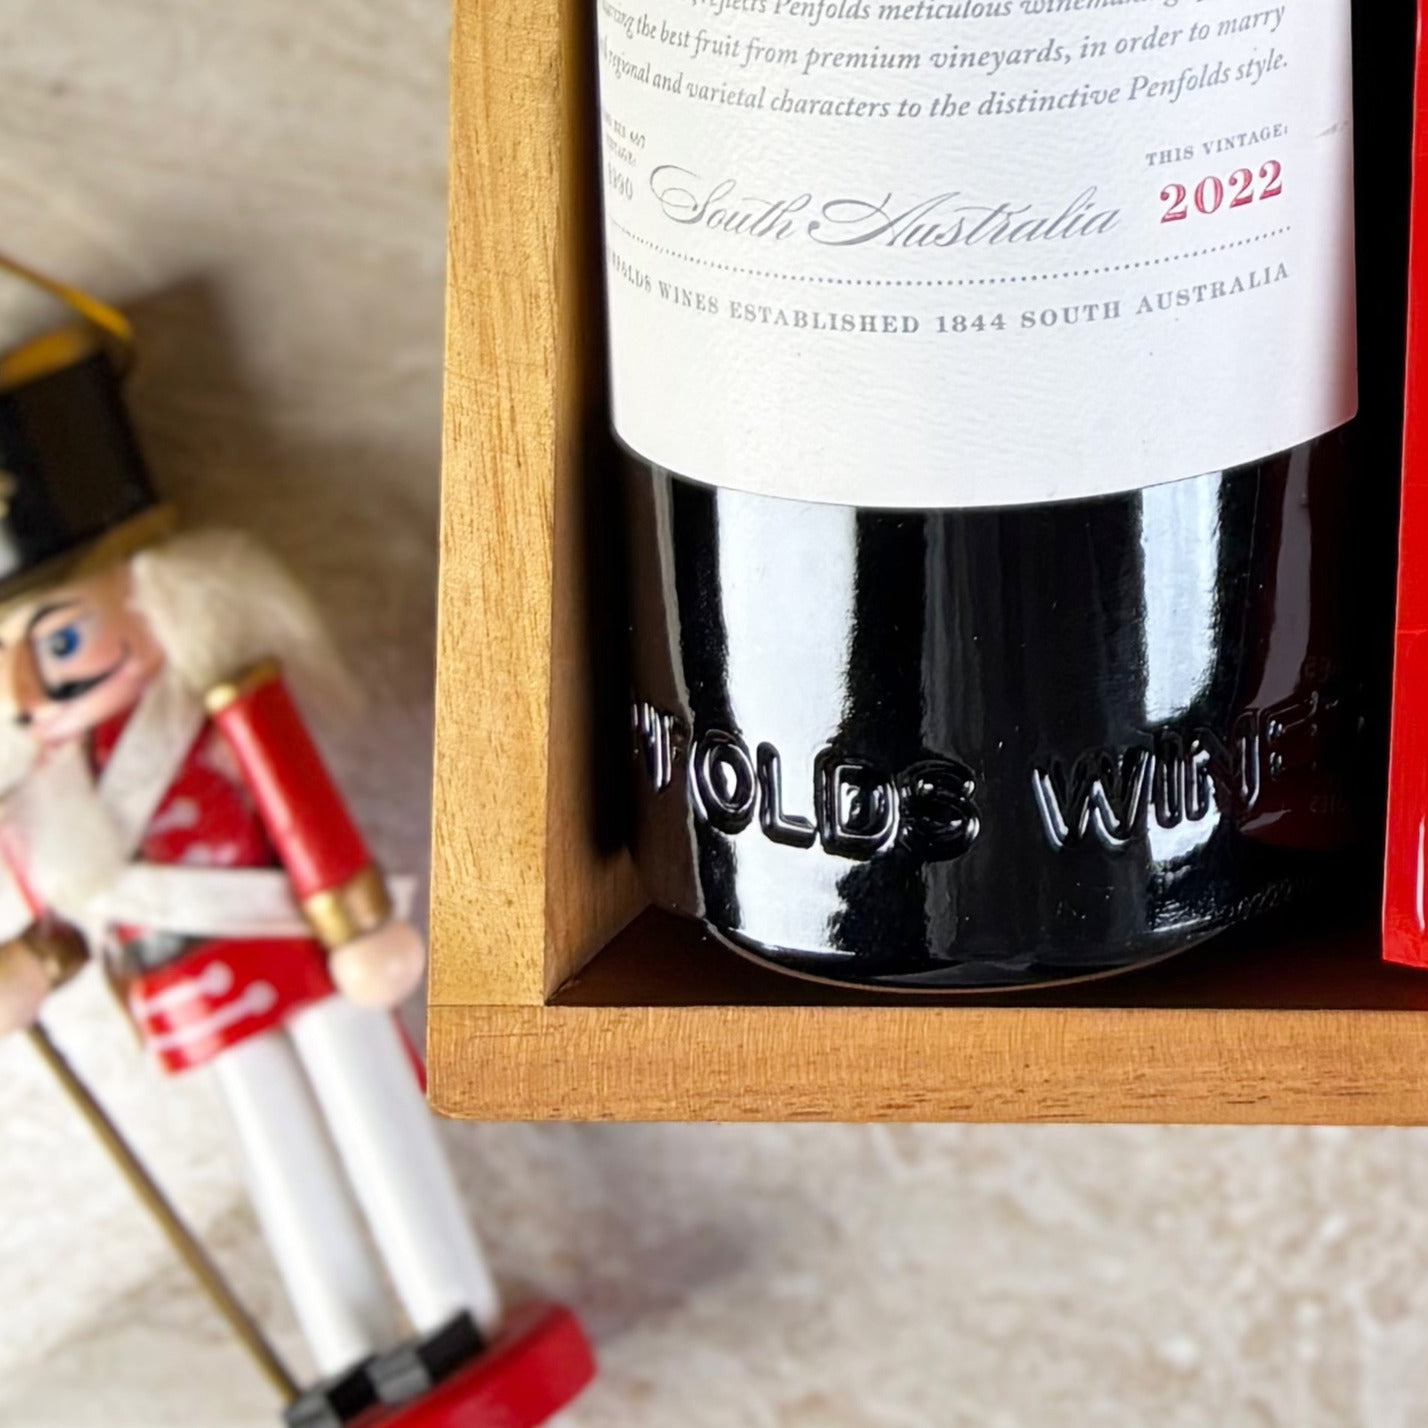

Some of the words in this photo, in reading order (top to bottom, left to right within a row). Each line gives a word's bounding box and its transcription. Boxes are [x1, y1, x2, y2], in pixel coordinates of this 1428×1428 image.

[802, 45, 920, 75] premium
[929, 38, 1071, 75] vineyards,
[1115, 24, 1183, 55] order
[1217, 4, 1286, 37] marry
[769, 88, 890, 118] characters
[928, 93, 970, 118] the
[977, 83, 1120, 116] distinctive
[1127, 56, 1231, 102] Penfolds
[650, 164, 813, 241] South
[808, 185, 1122, 247] Australia
[1160, 159, 1284, 224] 2022
[658, 281, 720, 314] WINES
[730, 300, 921, 335] ESTABLISHED
[936, 313, 1007, 333] 1844
[1021, 301, 1121, 329] SOUTH
[1136, 262, 1289, 315] AUSTRALIA
